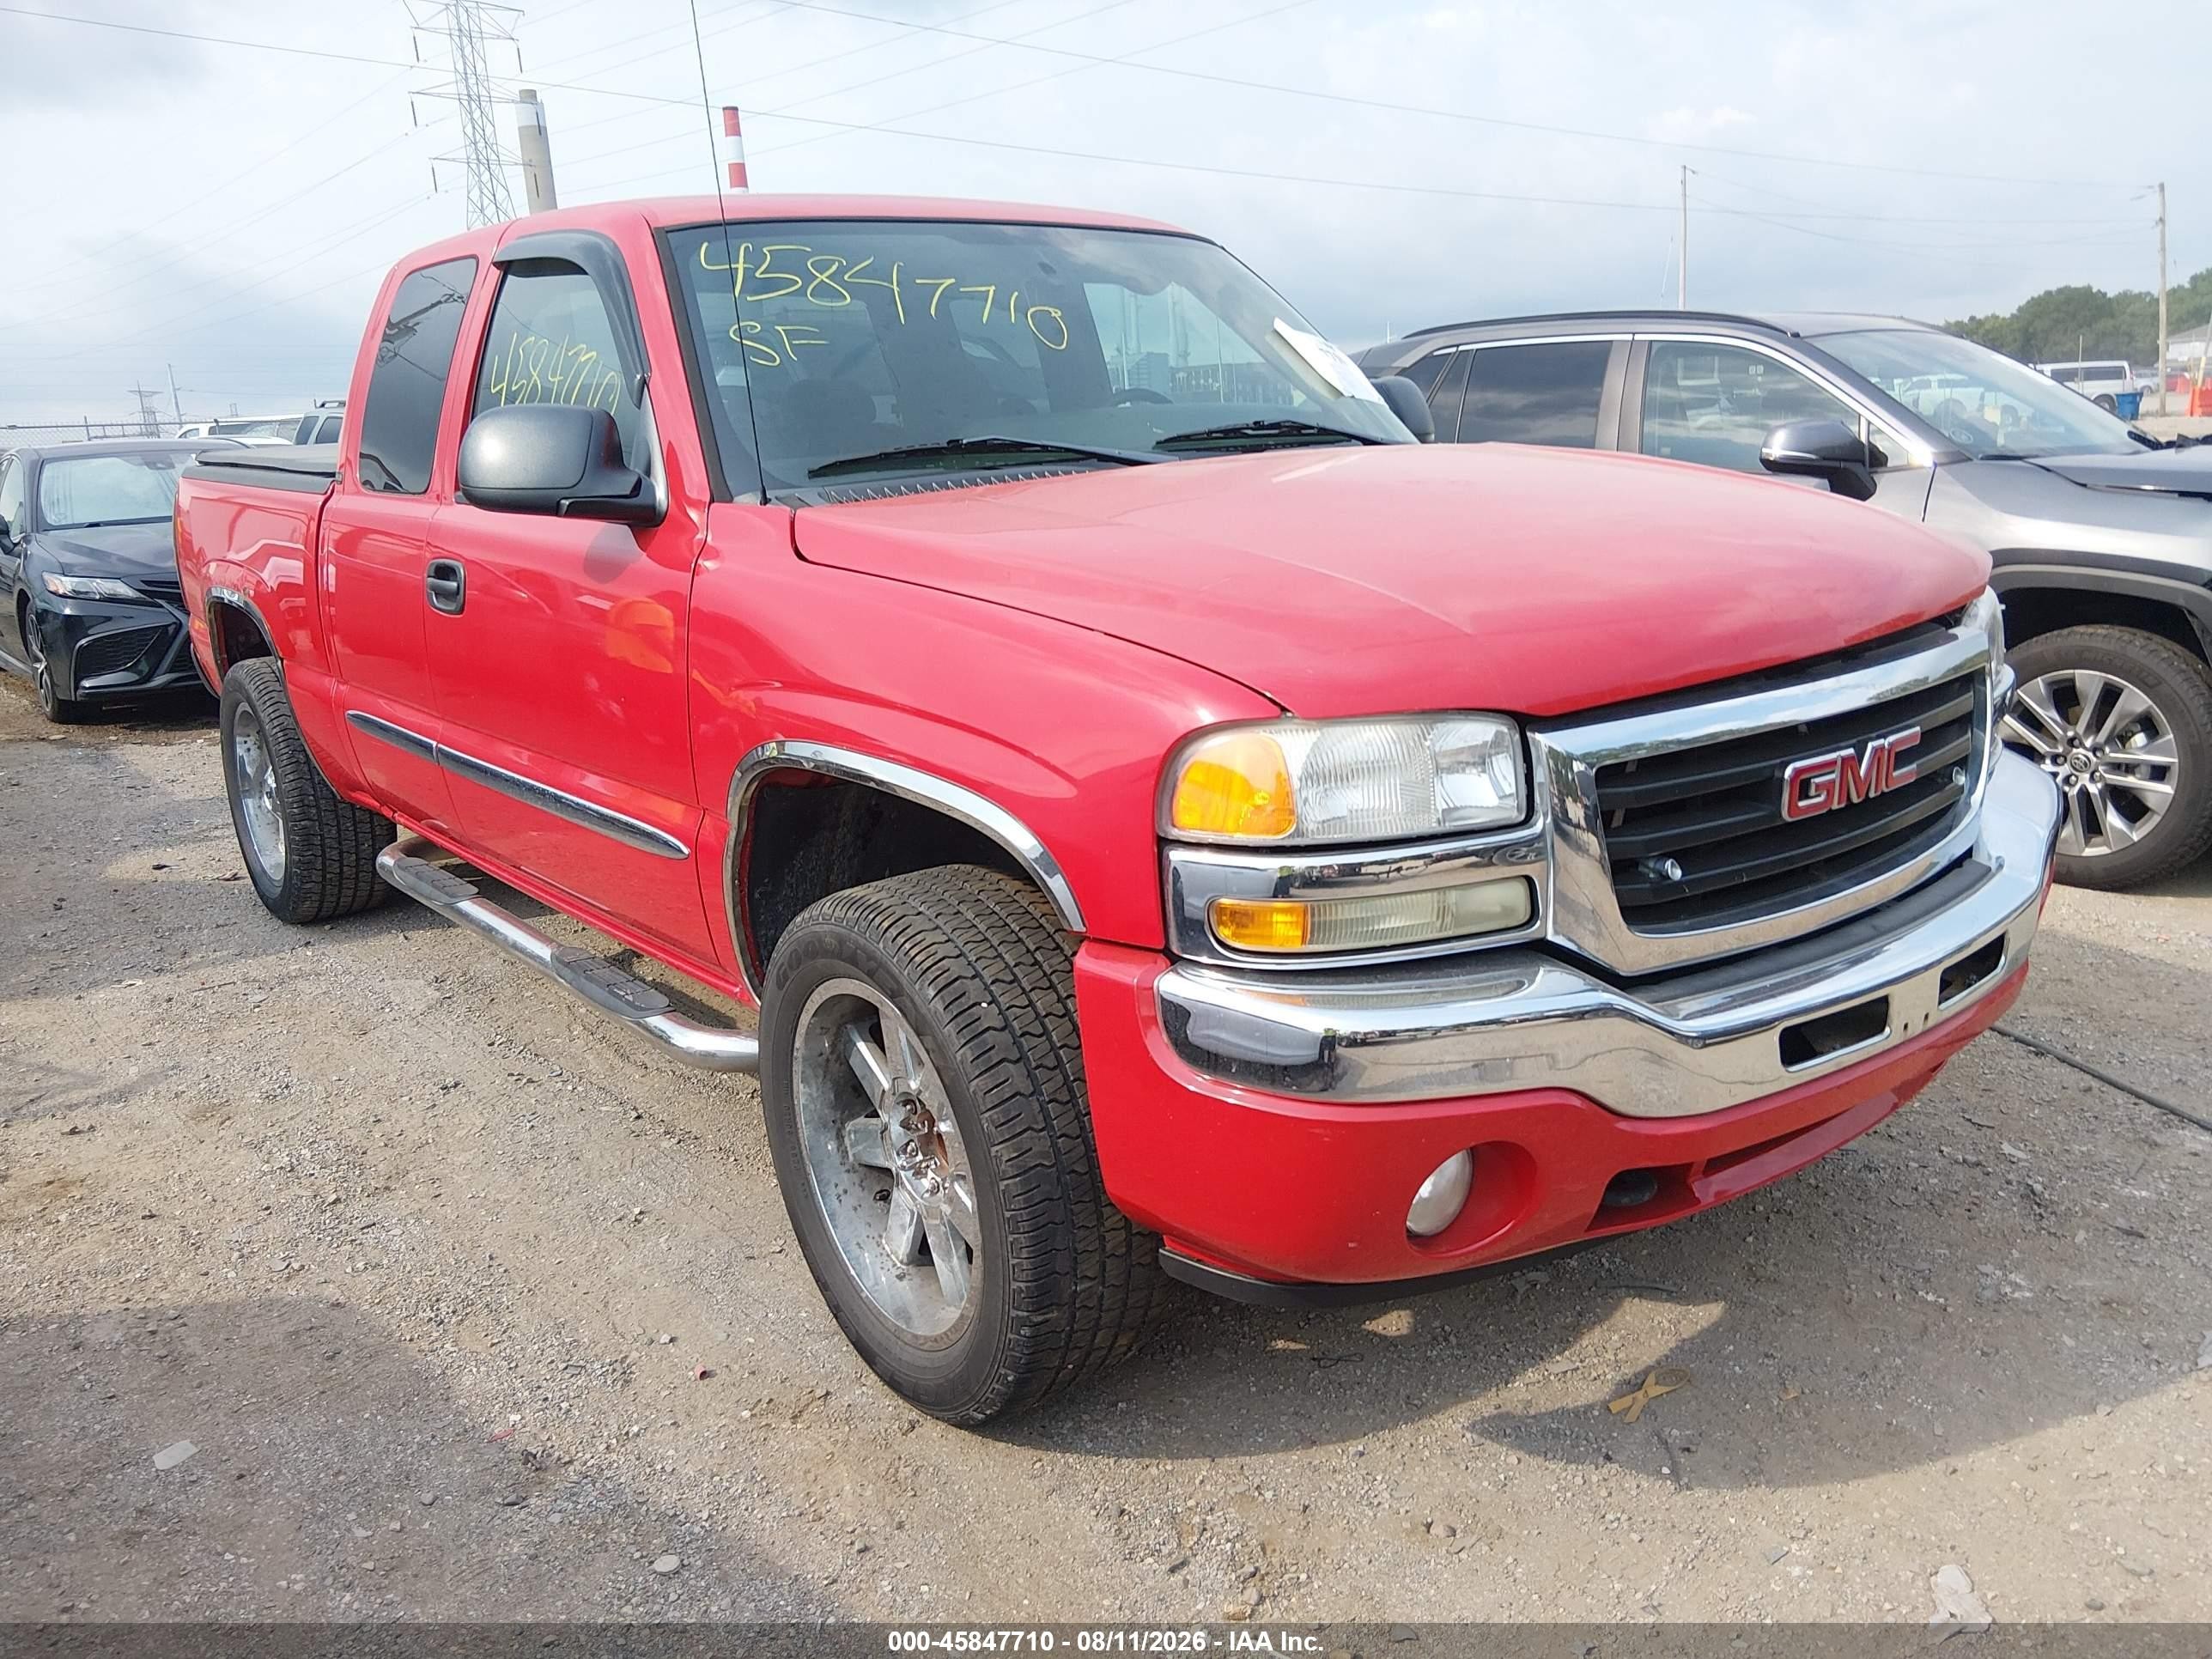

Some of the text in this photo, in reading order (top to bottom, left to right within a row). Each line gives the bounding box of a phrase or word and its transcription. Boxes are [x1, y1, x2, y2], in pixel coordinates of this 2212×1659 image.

[699, 241, 1068, 350] 45847710
[728, 321, 829, 367] SF
[1781, 726, 1922, 822] GMC
